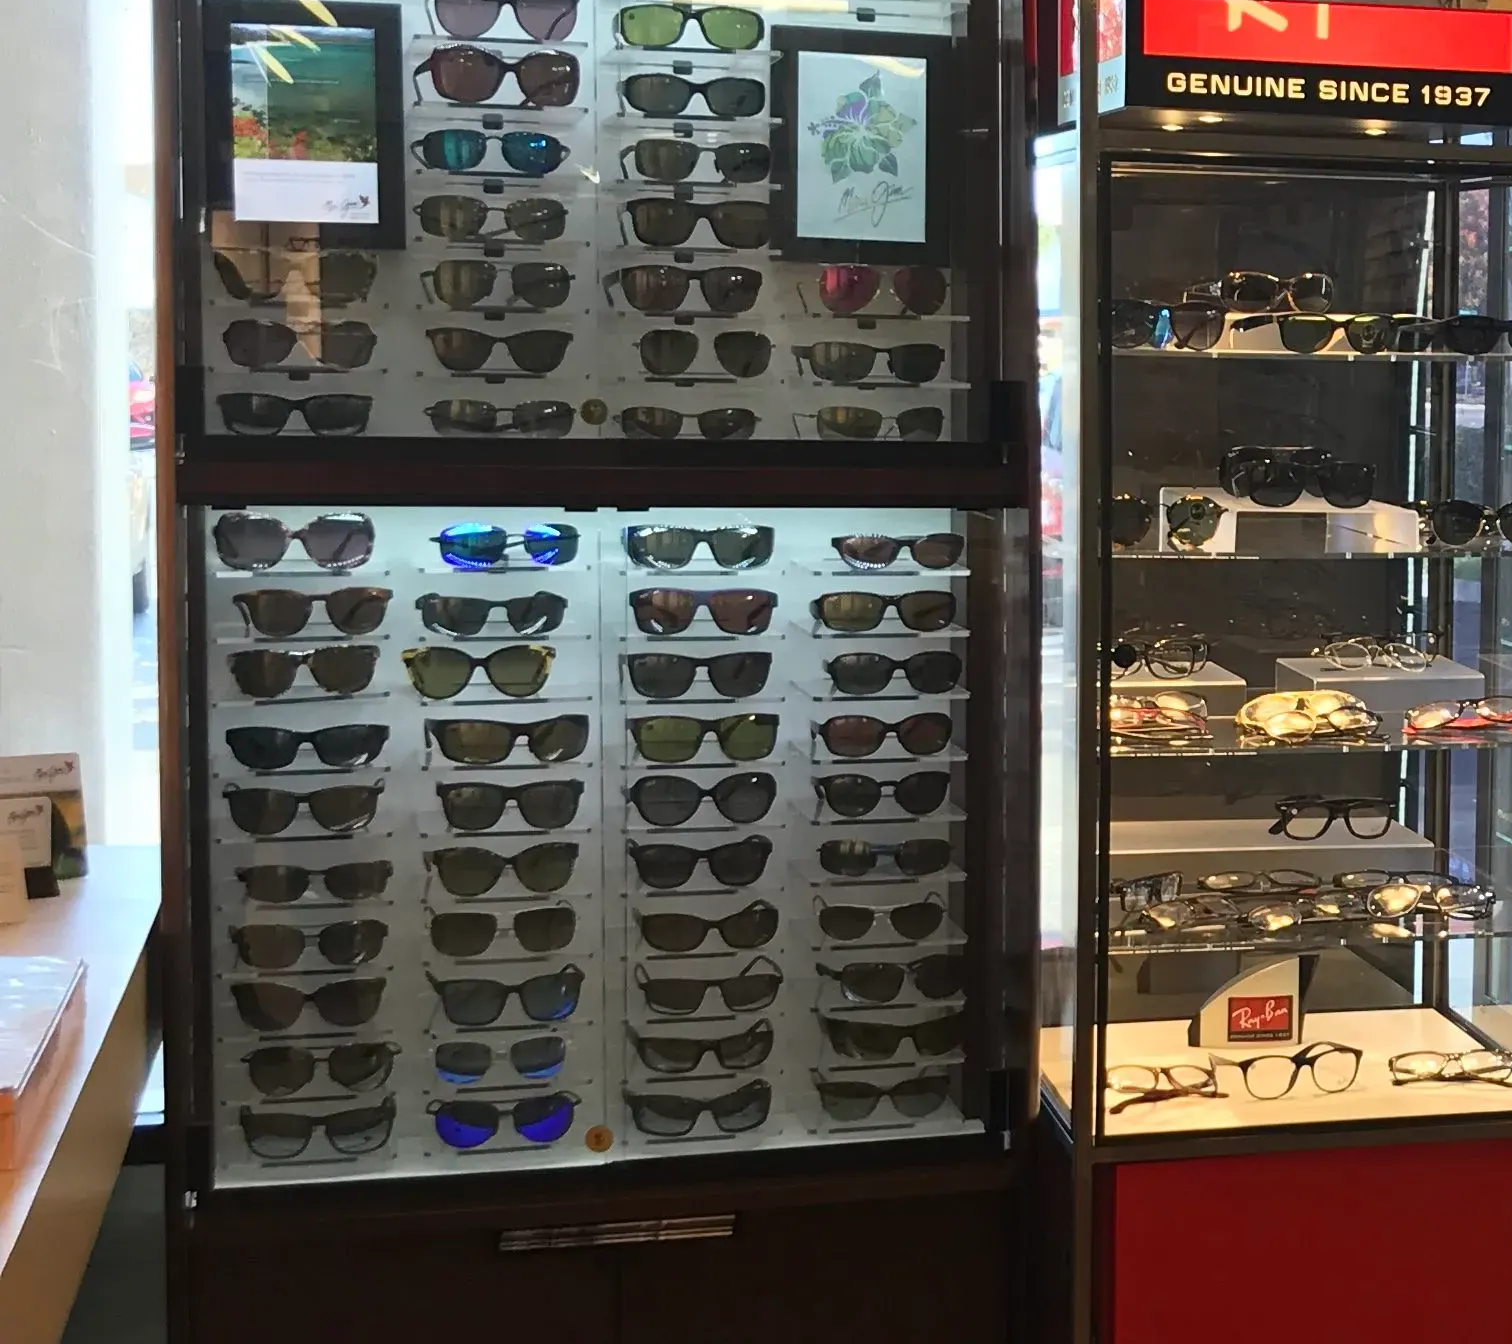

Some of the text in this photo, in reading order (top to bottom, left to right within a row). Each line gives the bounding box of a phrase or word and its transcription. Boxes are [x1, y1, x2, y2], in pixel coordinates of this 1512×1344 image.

[1166, 71, 1492, 107] GENUINE SINCE 1937
